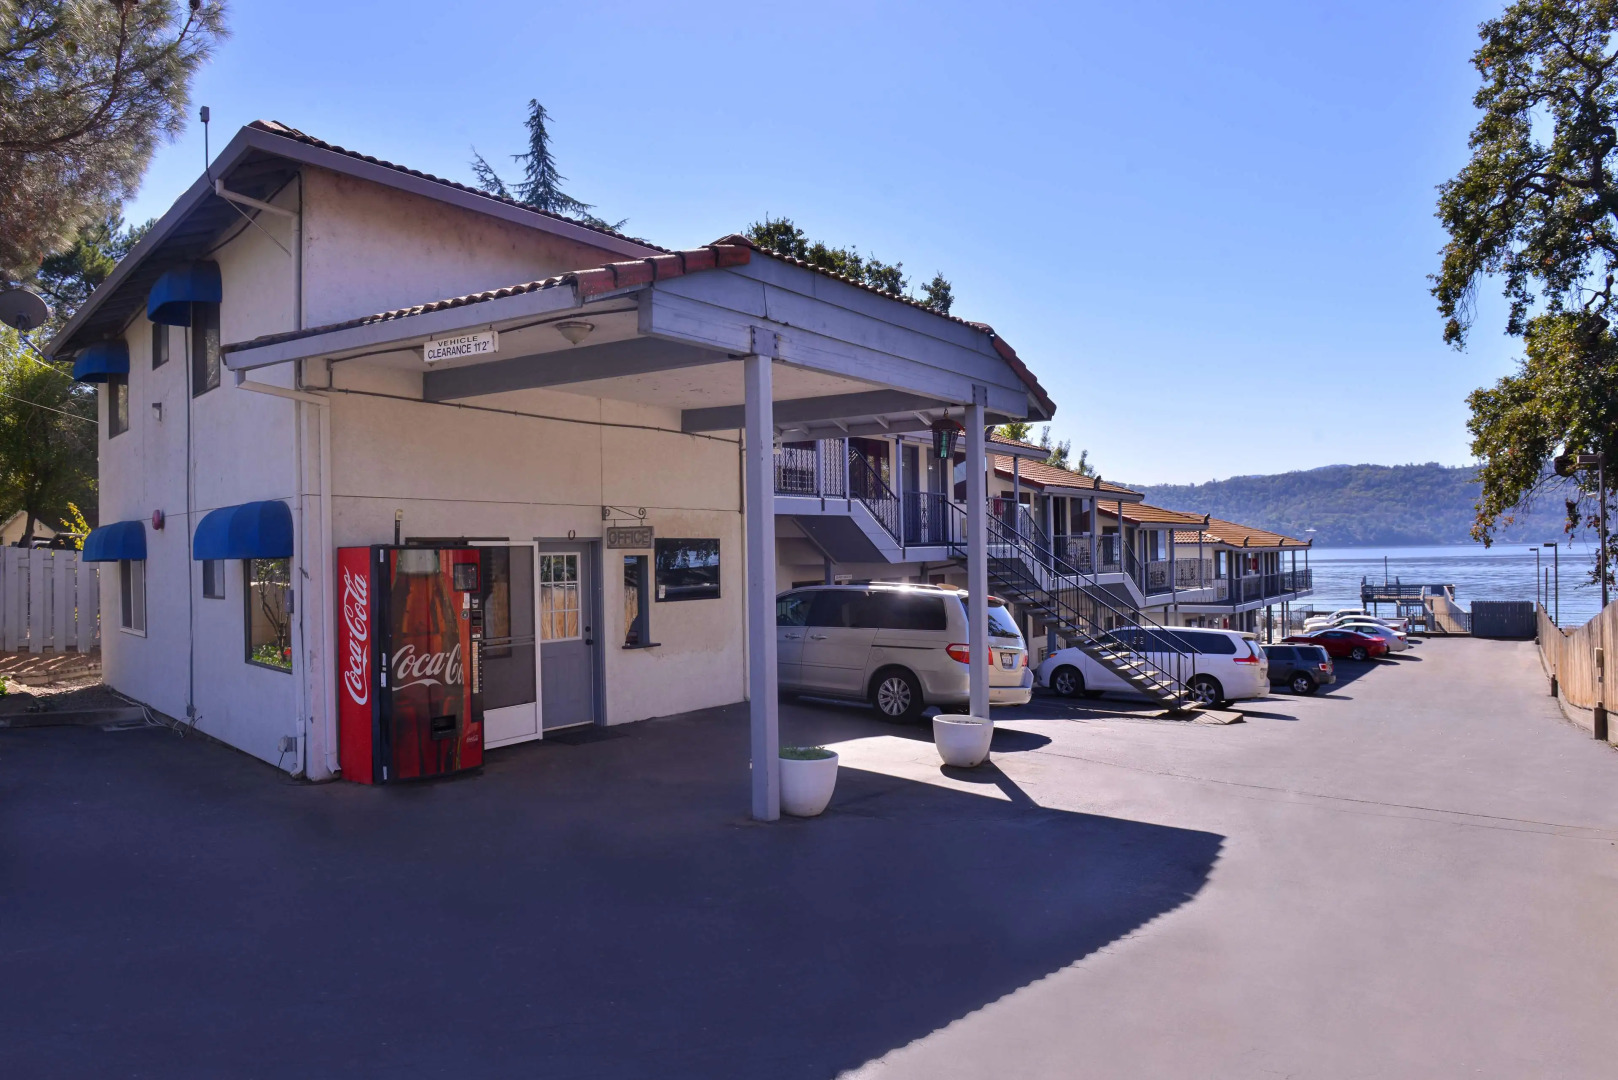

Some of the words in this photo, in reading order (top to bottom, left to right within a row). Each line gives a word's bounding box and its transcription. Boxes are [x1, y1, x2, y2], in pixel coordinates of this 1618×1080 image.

[438, 336, 478, 347] VEHICLE
[428, 343, 472, 359] CLEARANCE
[608, 529, 650, 546] OFFICE
[343, 565, 368, 706] Coca-Cola
